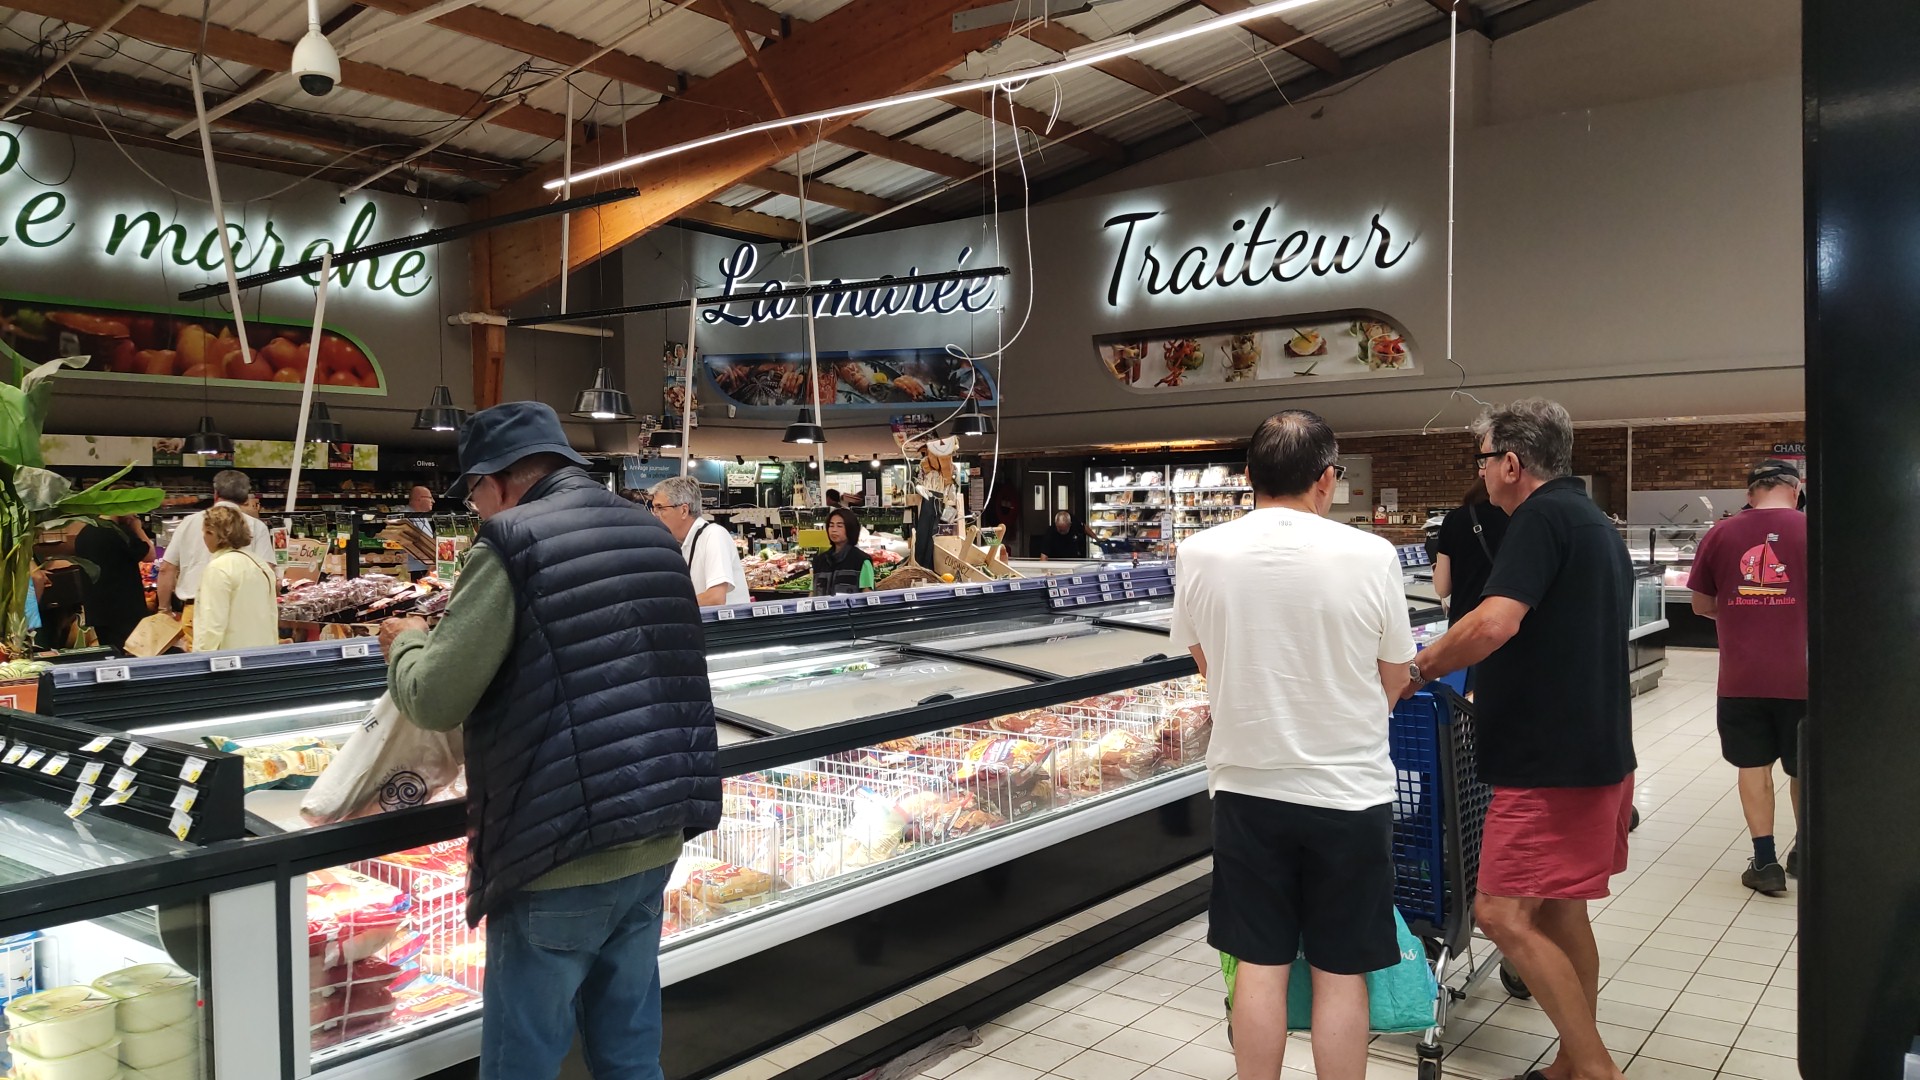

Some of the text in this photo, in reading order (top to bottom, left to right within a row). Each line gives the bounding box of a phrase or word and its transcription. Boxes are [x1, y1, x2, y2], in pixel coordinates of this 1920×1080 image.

[702, 243, 997, 327] La marée
[1104, 206, 1411, 307] Traiteur
[1735, 596, 1759, 605] Route
